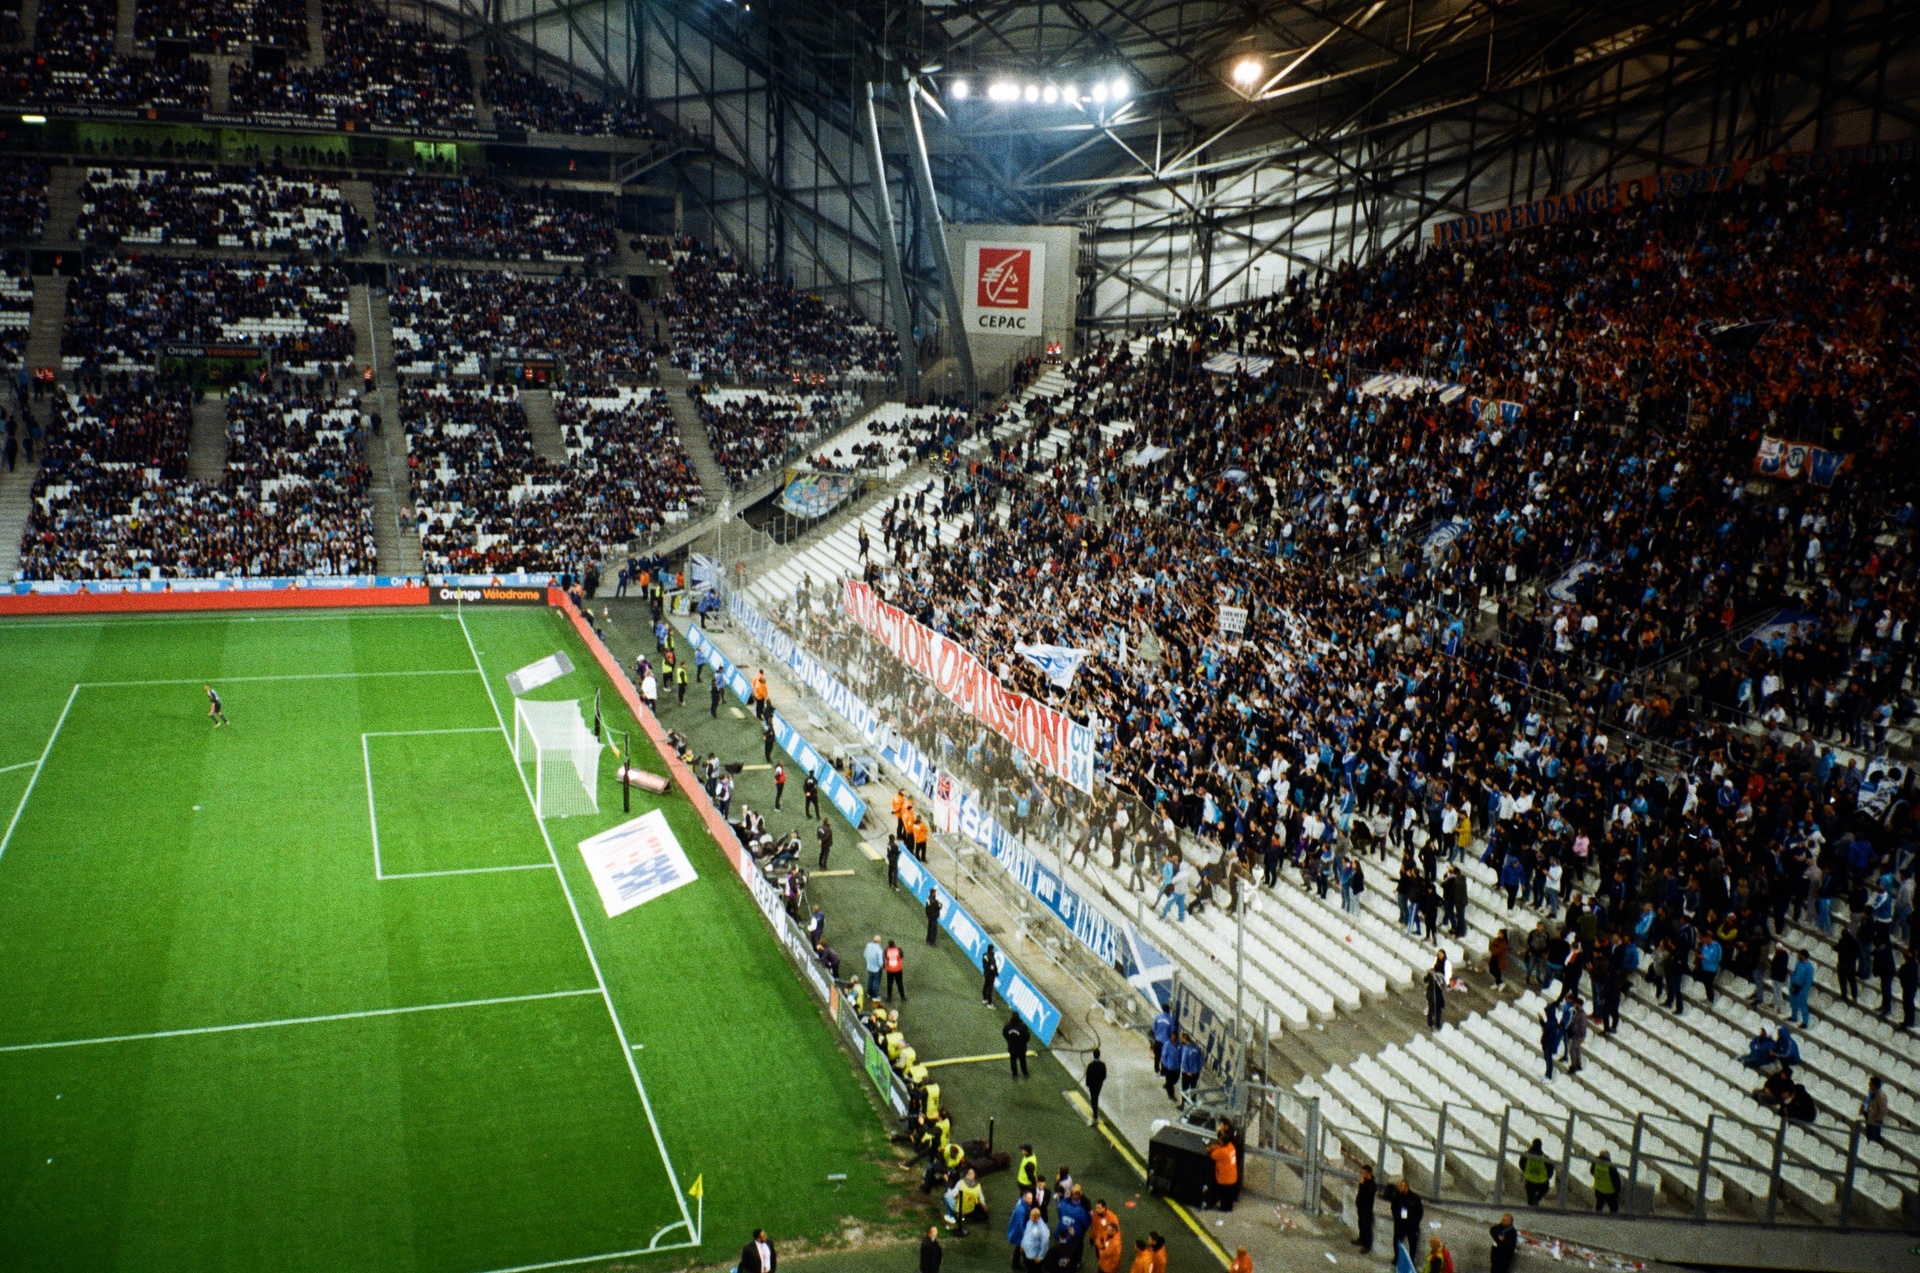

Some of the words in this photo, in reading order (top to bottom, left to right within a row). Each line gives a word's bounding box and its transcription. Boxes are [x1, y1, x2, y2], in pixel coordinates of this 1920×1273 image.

[1438, 184, 1620, 244] INDEPENDANCE
[1655, 163, 1733, 197] 1987
[979, 315, 1026, 329] CEPAC
[167, 346, 204, 358] Orange
[440, 588, 481, 602] Orange
[482, 587, 540, 600] Vélodrome
[1070, 724, 1093, 757] CU
[1070, 754, 1089, 791] 84
[961, 797, 995, 852] 84
